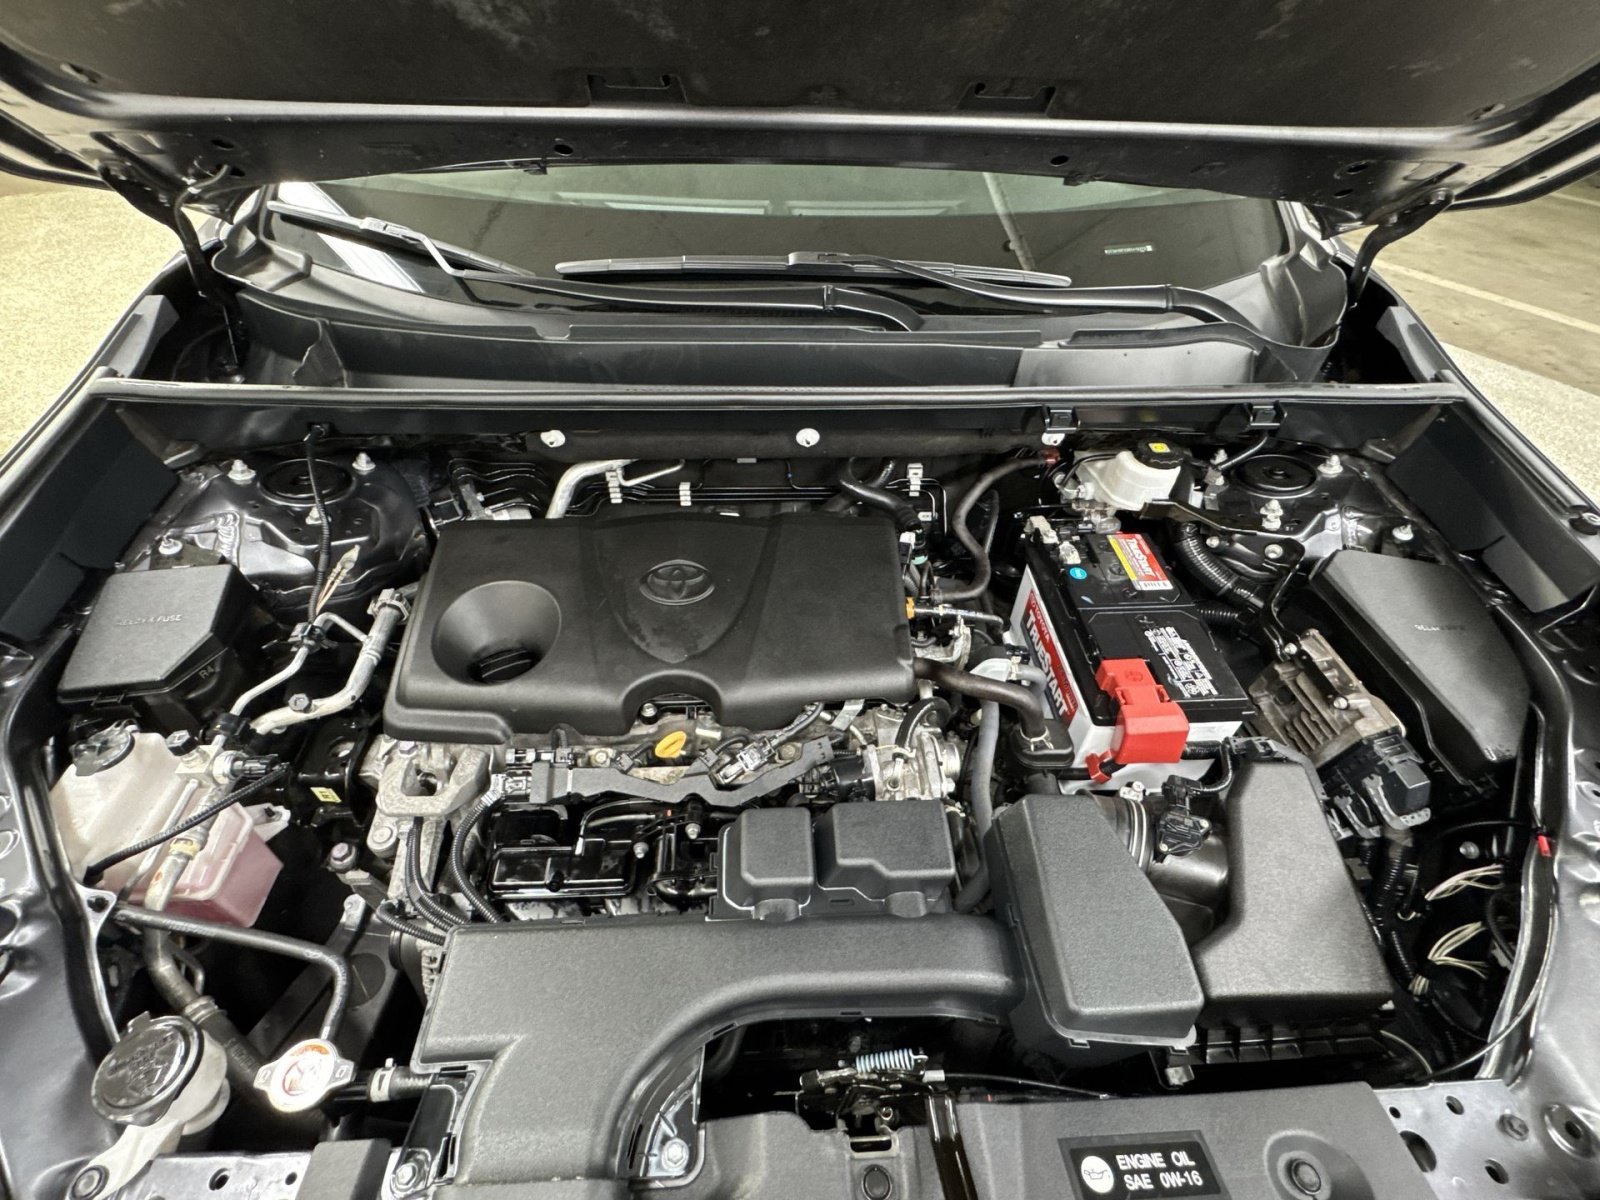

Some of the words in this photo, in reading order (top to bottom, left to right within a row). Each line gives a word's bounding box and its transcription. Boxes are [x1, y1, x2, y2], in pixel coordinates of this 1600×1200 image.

[156, 613, 183, 623] FUSE
[1025, 614, 1069, 717] TRUESTART
[1115, 1151, 1166, 1171] ENGINE
[1170, 1150, 1196, 1168] OIL
[1123, 1173, 1154, 1191] SAE
[1159, 1169, 1204, 1189] 0W-16
